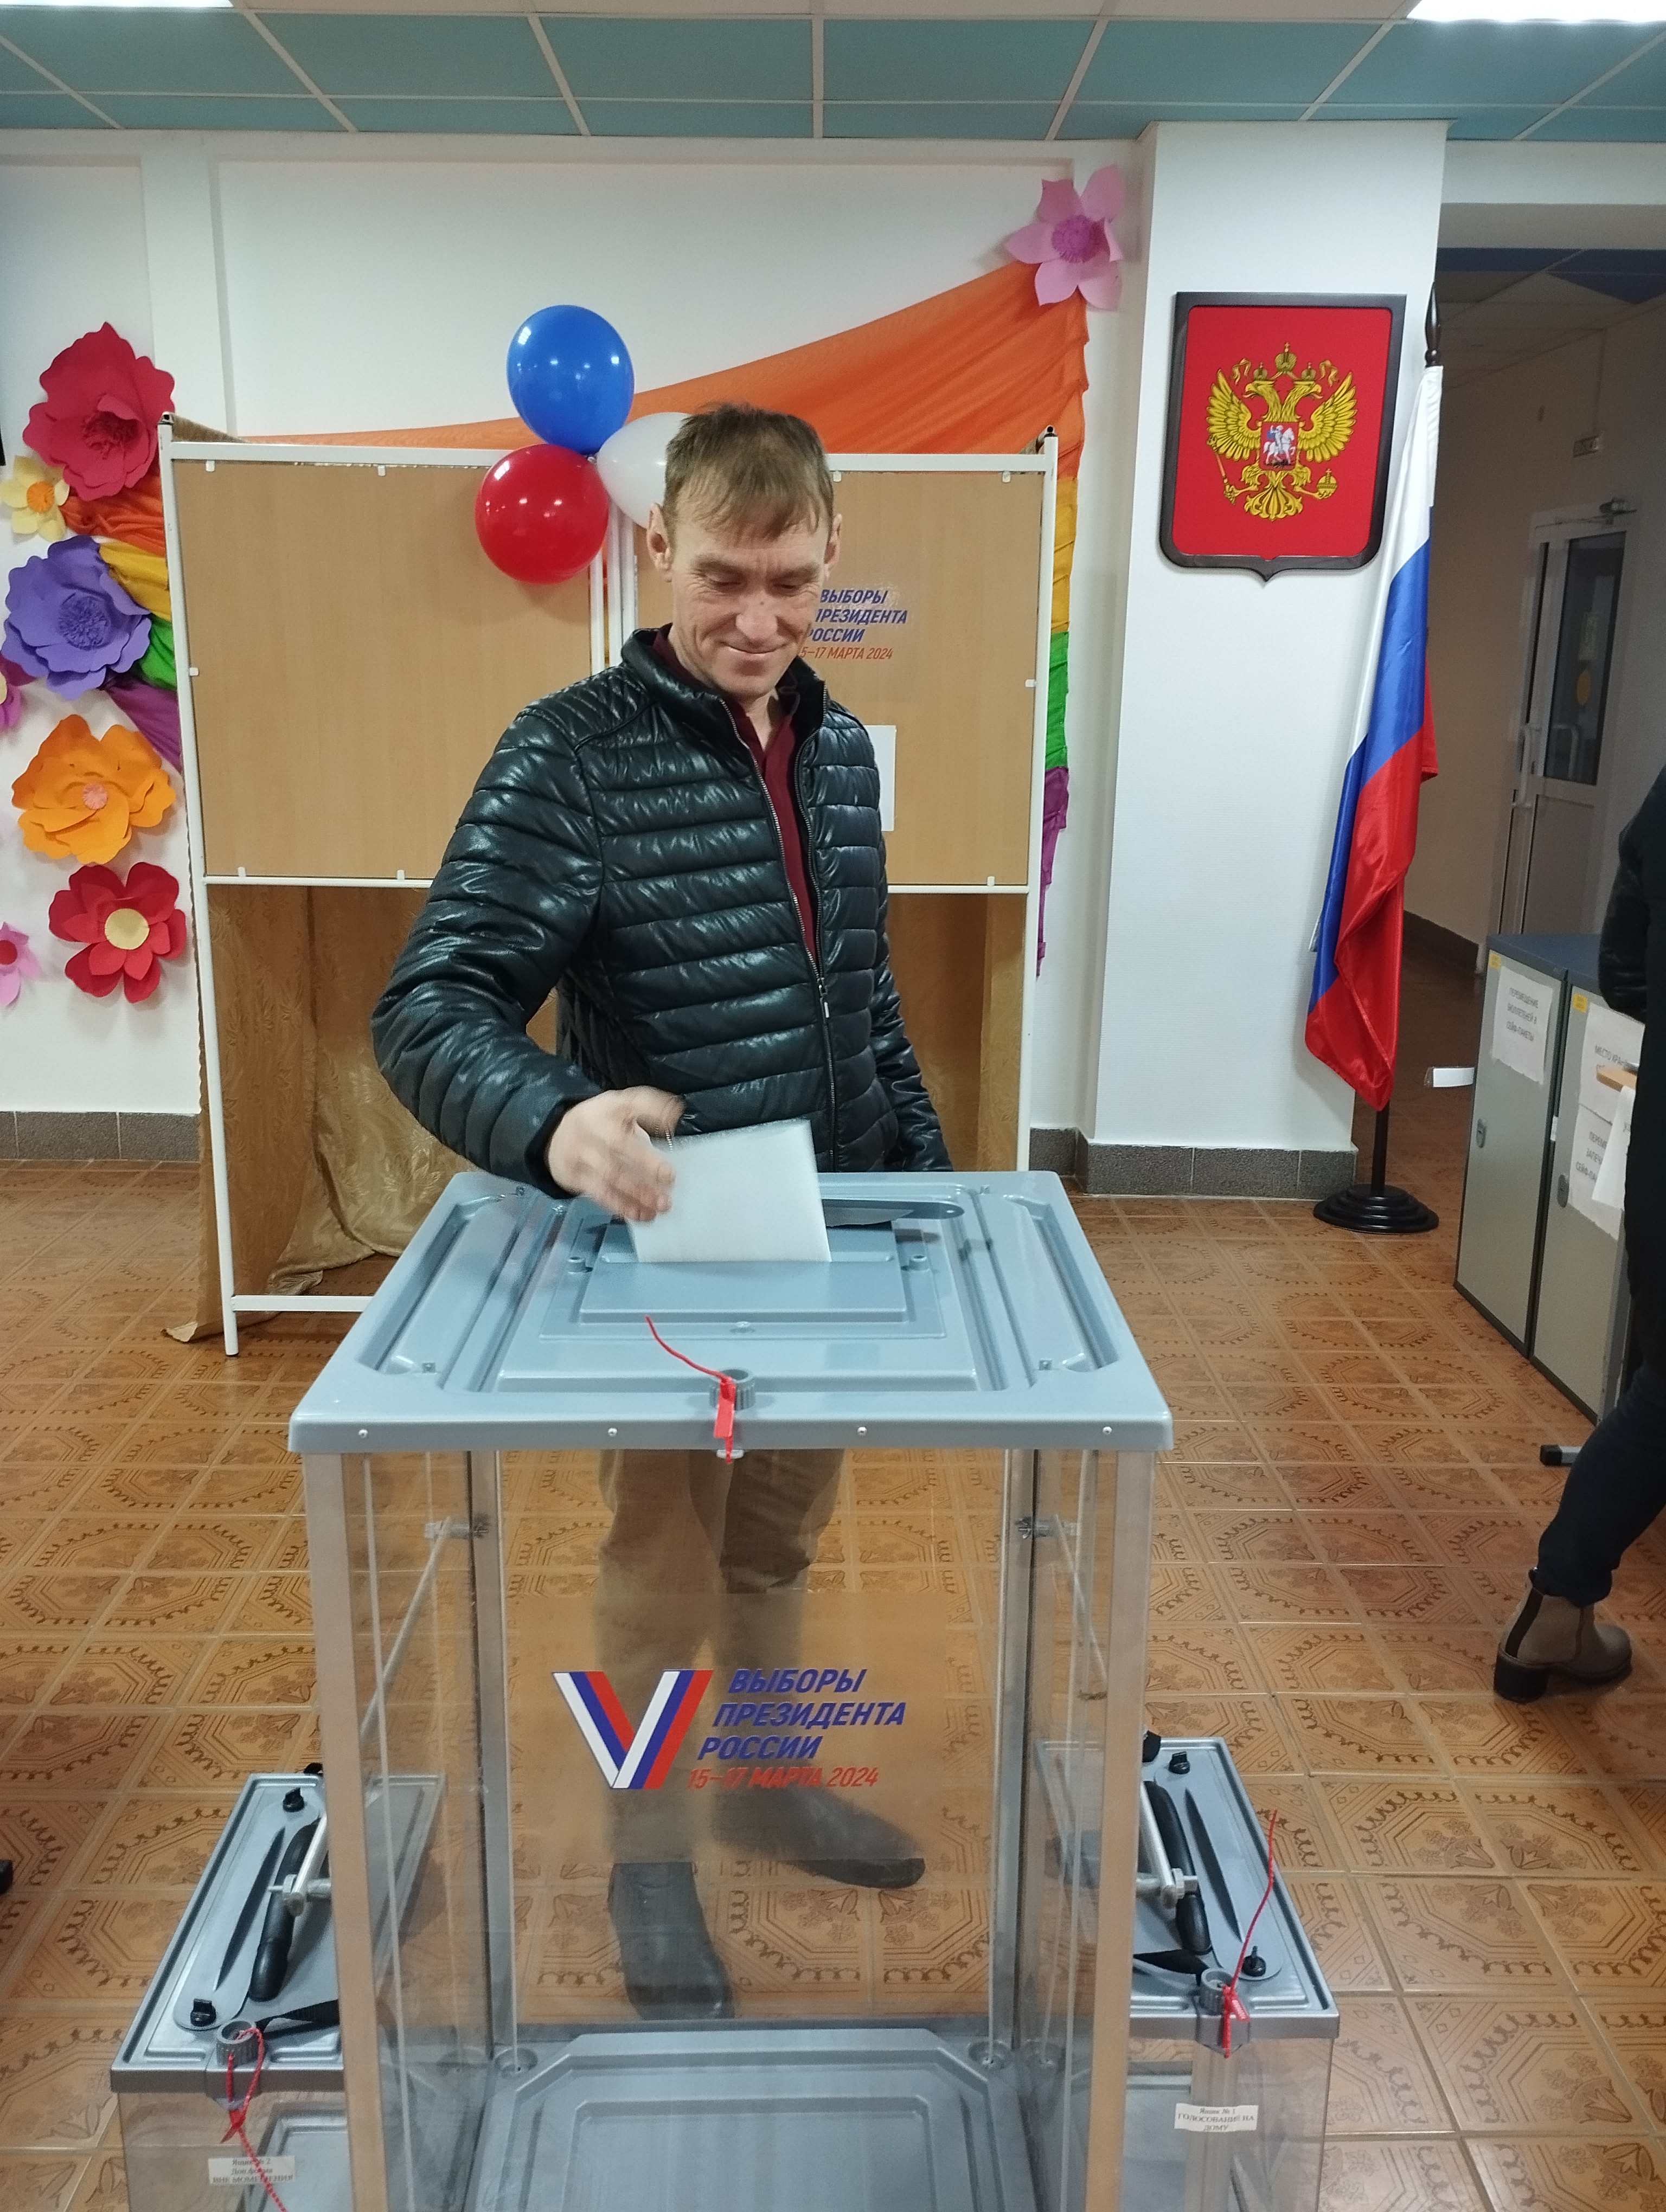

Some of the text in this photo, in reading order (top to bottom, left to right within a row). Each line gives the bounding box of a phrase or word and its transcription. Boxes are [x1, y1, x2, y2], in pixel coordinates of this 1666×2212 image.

[820, 589, 888, 604] ВЫБОРЫ
[808, 628, 866, 642] ОССИИ
[826, 647, 864, 659] МАРТА
[866, 647, 894, 660] 2024
[728, 1668, 868, 1693] ВЫБОРЫ
[713, 1702, 907, 1729] ПРЕЗИДЕНТА
[697, 1735, 823, 1760] РОССИИ
[748, 1766, 823, 1788] МАРТА
[825, 1766, 879, 1787] 2024
[1178, 2113, 1240, 2123] ГОЛОСОВАНИЕ
